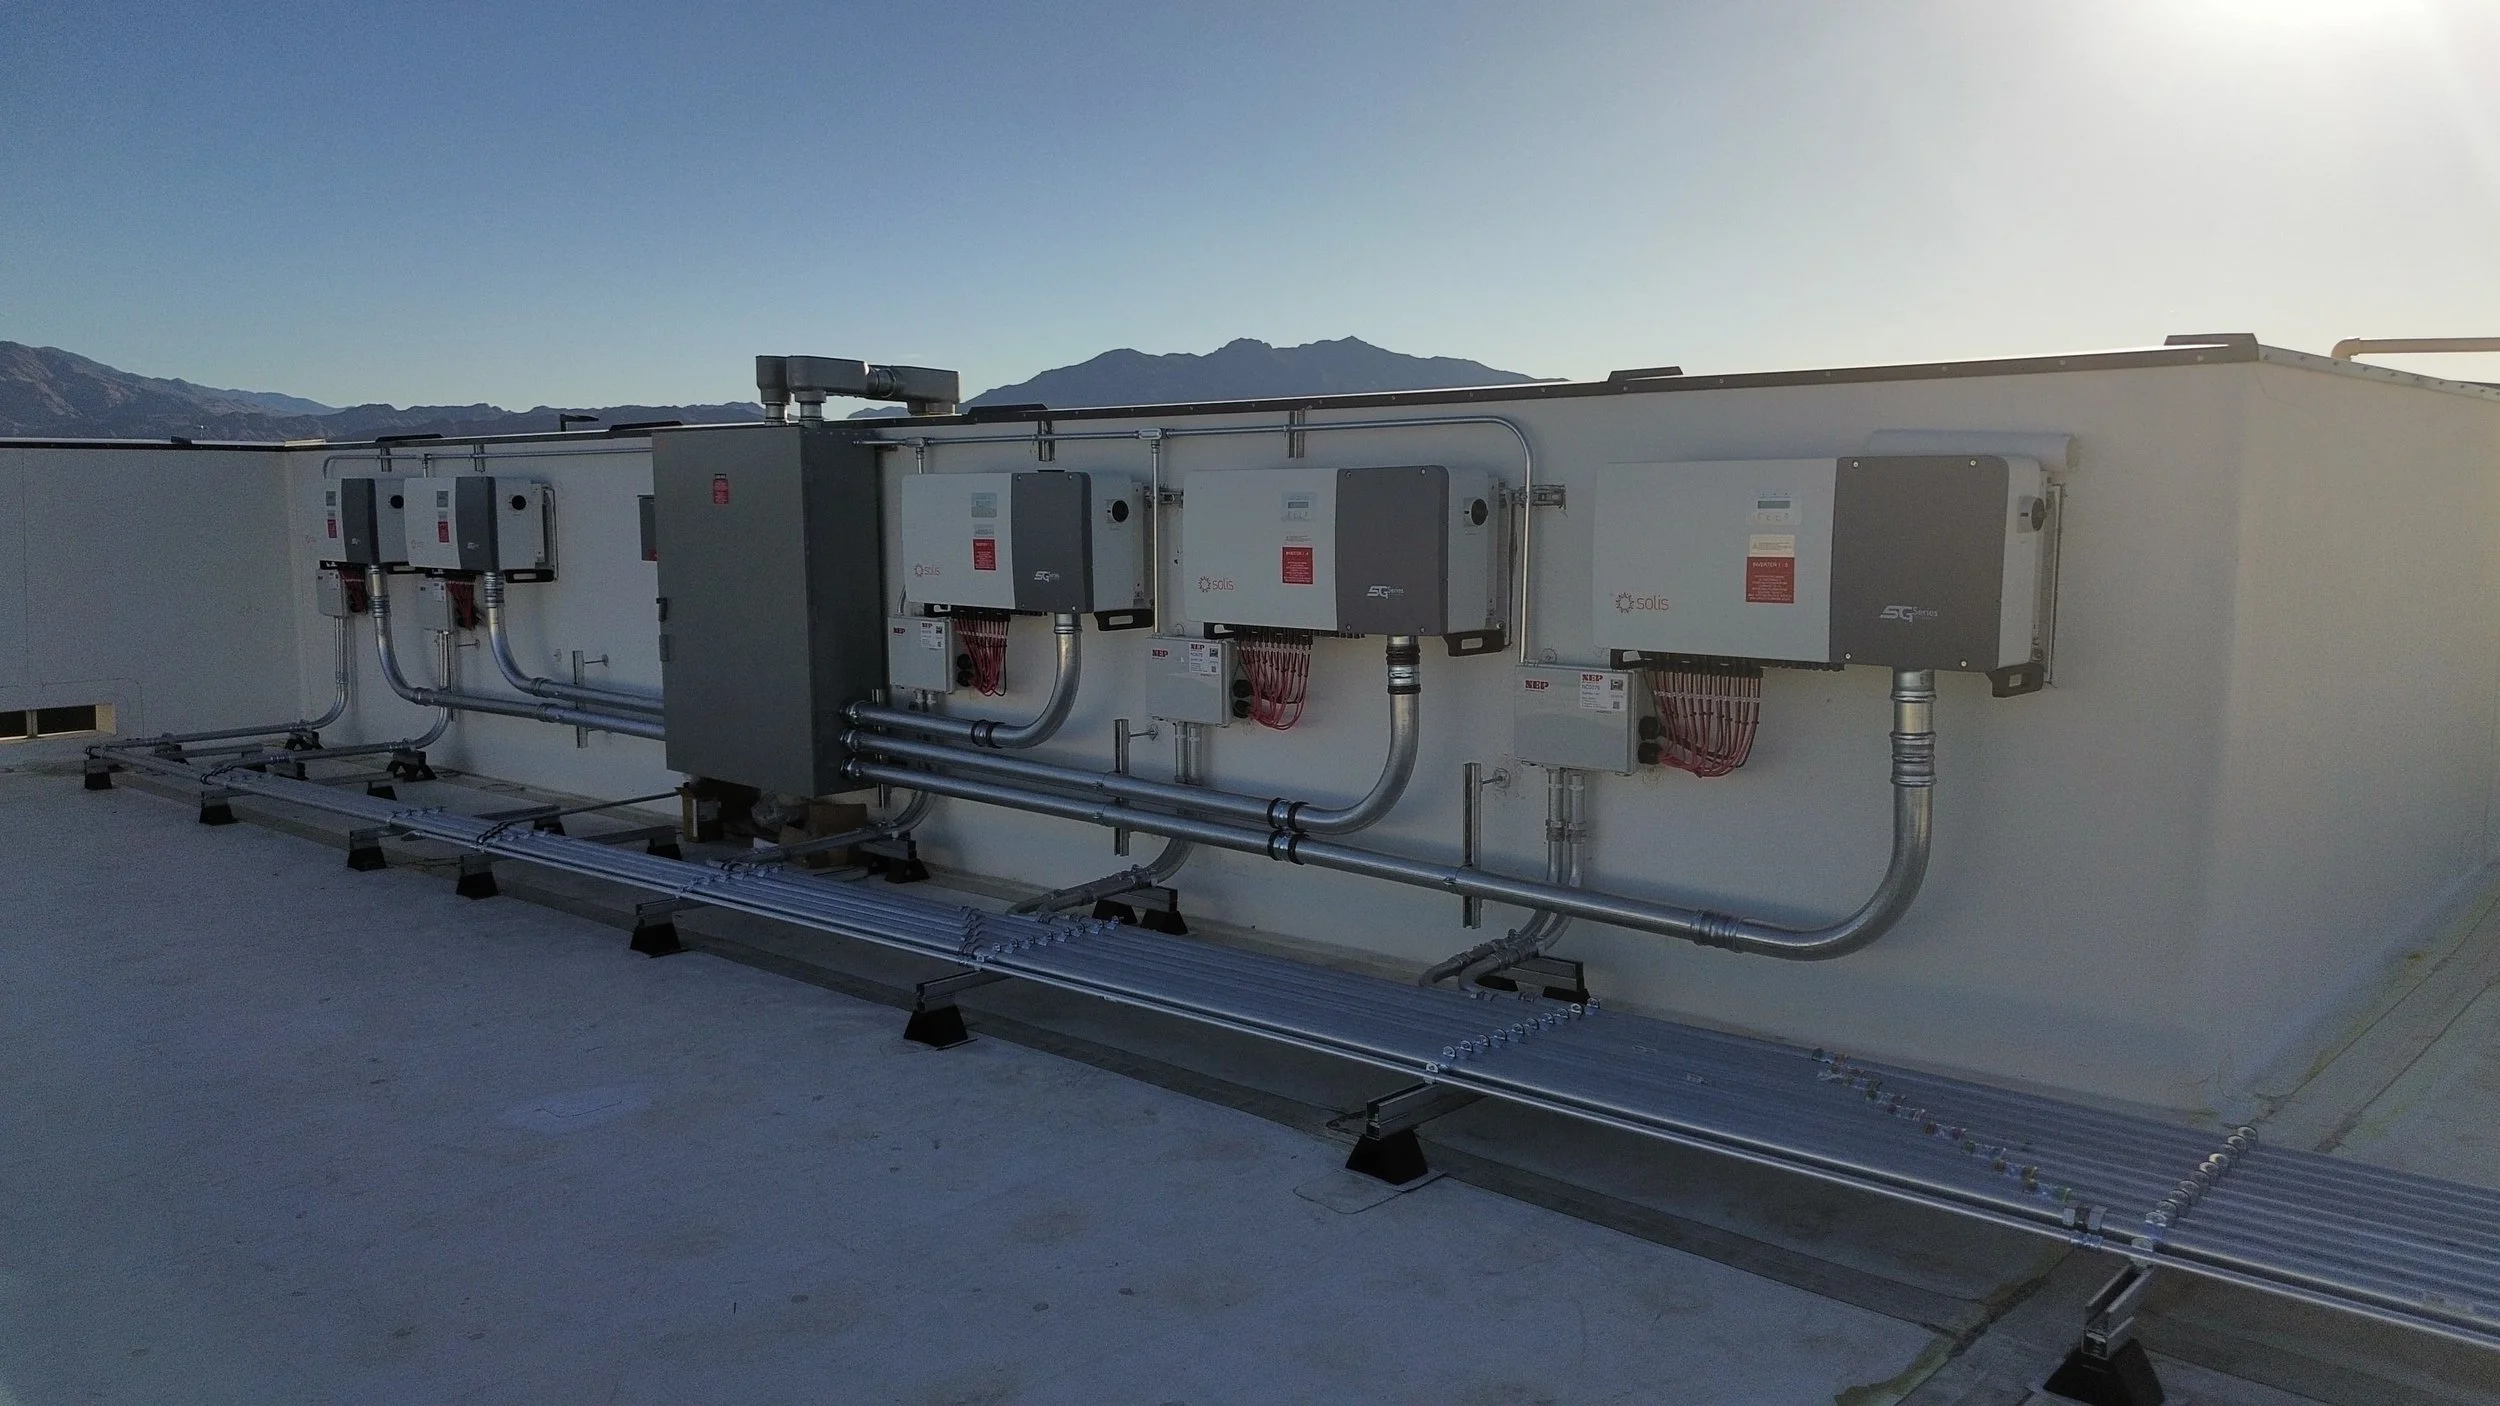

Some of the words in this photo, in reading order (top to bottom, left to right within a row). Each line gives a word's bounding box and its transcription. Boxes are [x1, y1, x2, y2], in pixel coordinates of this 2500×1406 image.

[1212, 577, 1234, 590] solis
[1636, 595, 1669, 611] solis
[1912, 606, 1939, 617] Series
[1151, 649, 1169, 658] NEP
[1582, 673, 1604, 682] NEP
[1524, 679, 1550, 690] NEP
